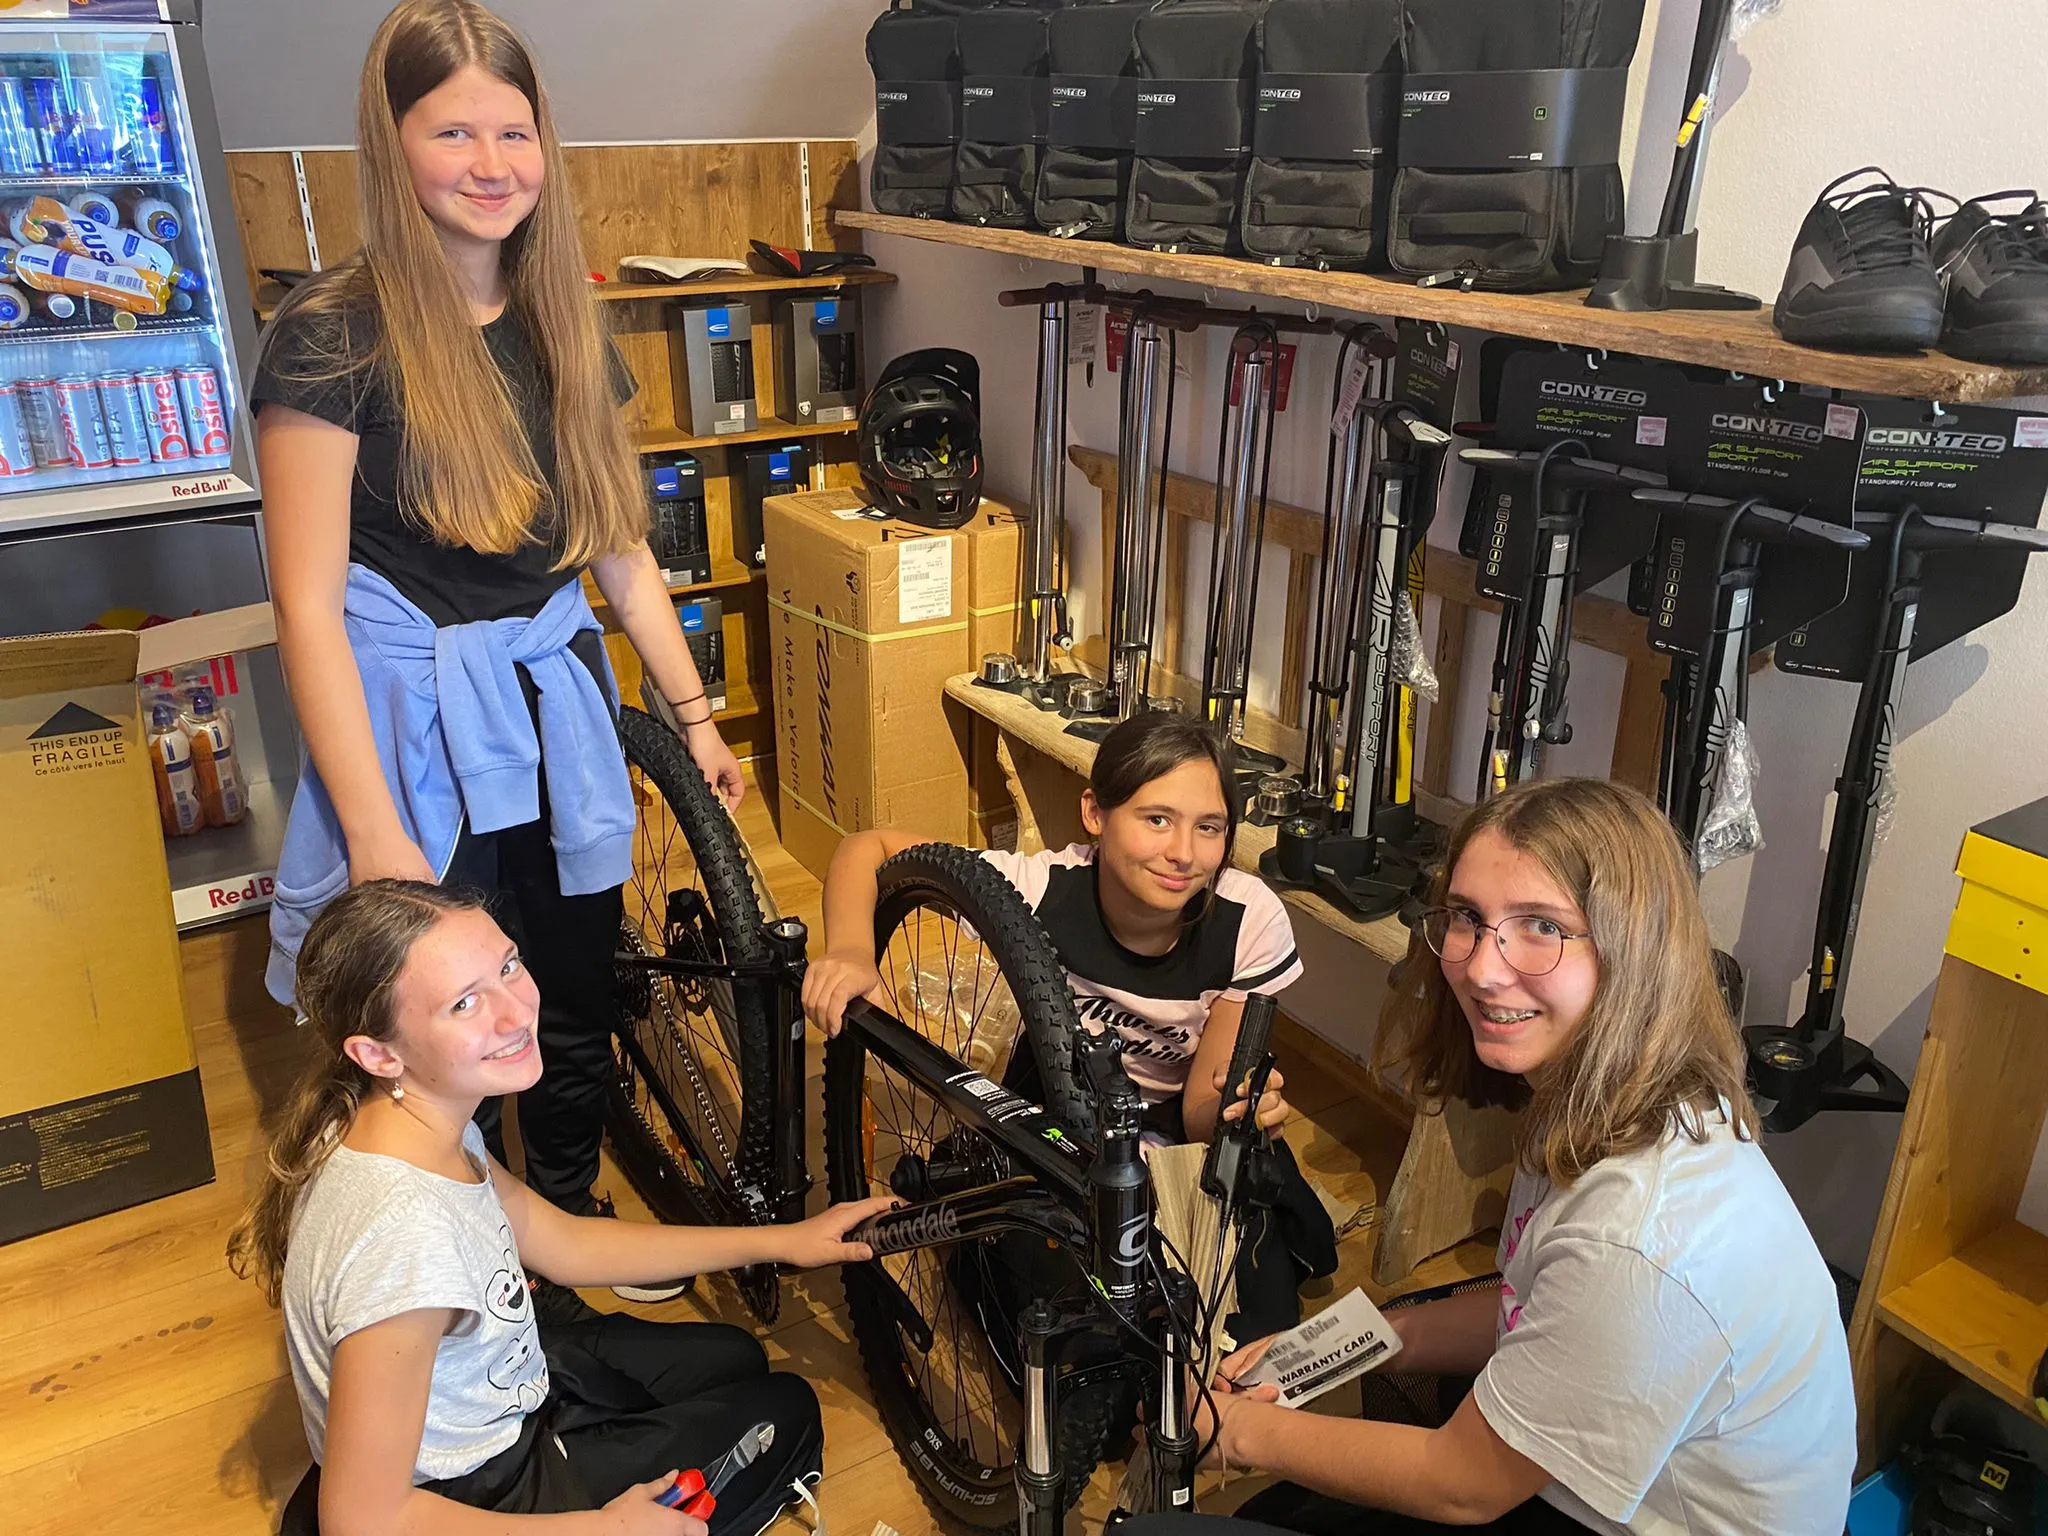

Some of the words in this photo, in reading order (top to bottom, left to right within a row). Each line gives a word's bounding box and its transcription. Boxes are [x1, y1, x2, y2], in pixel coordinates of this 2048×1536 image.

[1536, 415, 1582, 425] SPORT
[1561, 409, 1627, 424] SUPPORT
[1707, 451, 1759, 462] SPORT
[1736, 445, 1803, 462] SUPPORT
[1861, 468, 1920, 477] SPORT
[1894, 459, 1979, 472] SUPPORT
[1368, 650, 1388, 767] SUPPORT
[29, 739, 65, 753] THIS
[69, 735, 99, 747] END
[104, 731, 122, 742] UP
[32, 743, 125, 767] FRAGILE
[73, 763, 93, 771] vers
[105, 757, 126, 766] haut
[1277, 1349, 1342, 1386] WARRANTY
[1344, 1330, 1375, 1353] CARD
[909, 1439, 999, 1506] SCHWALBE
